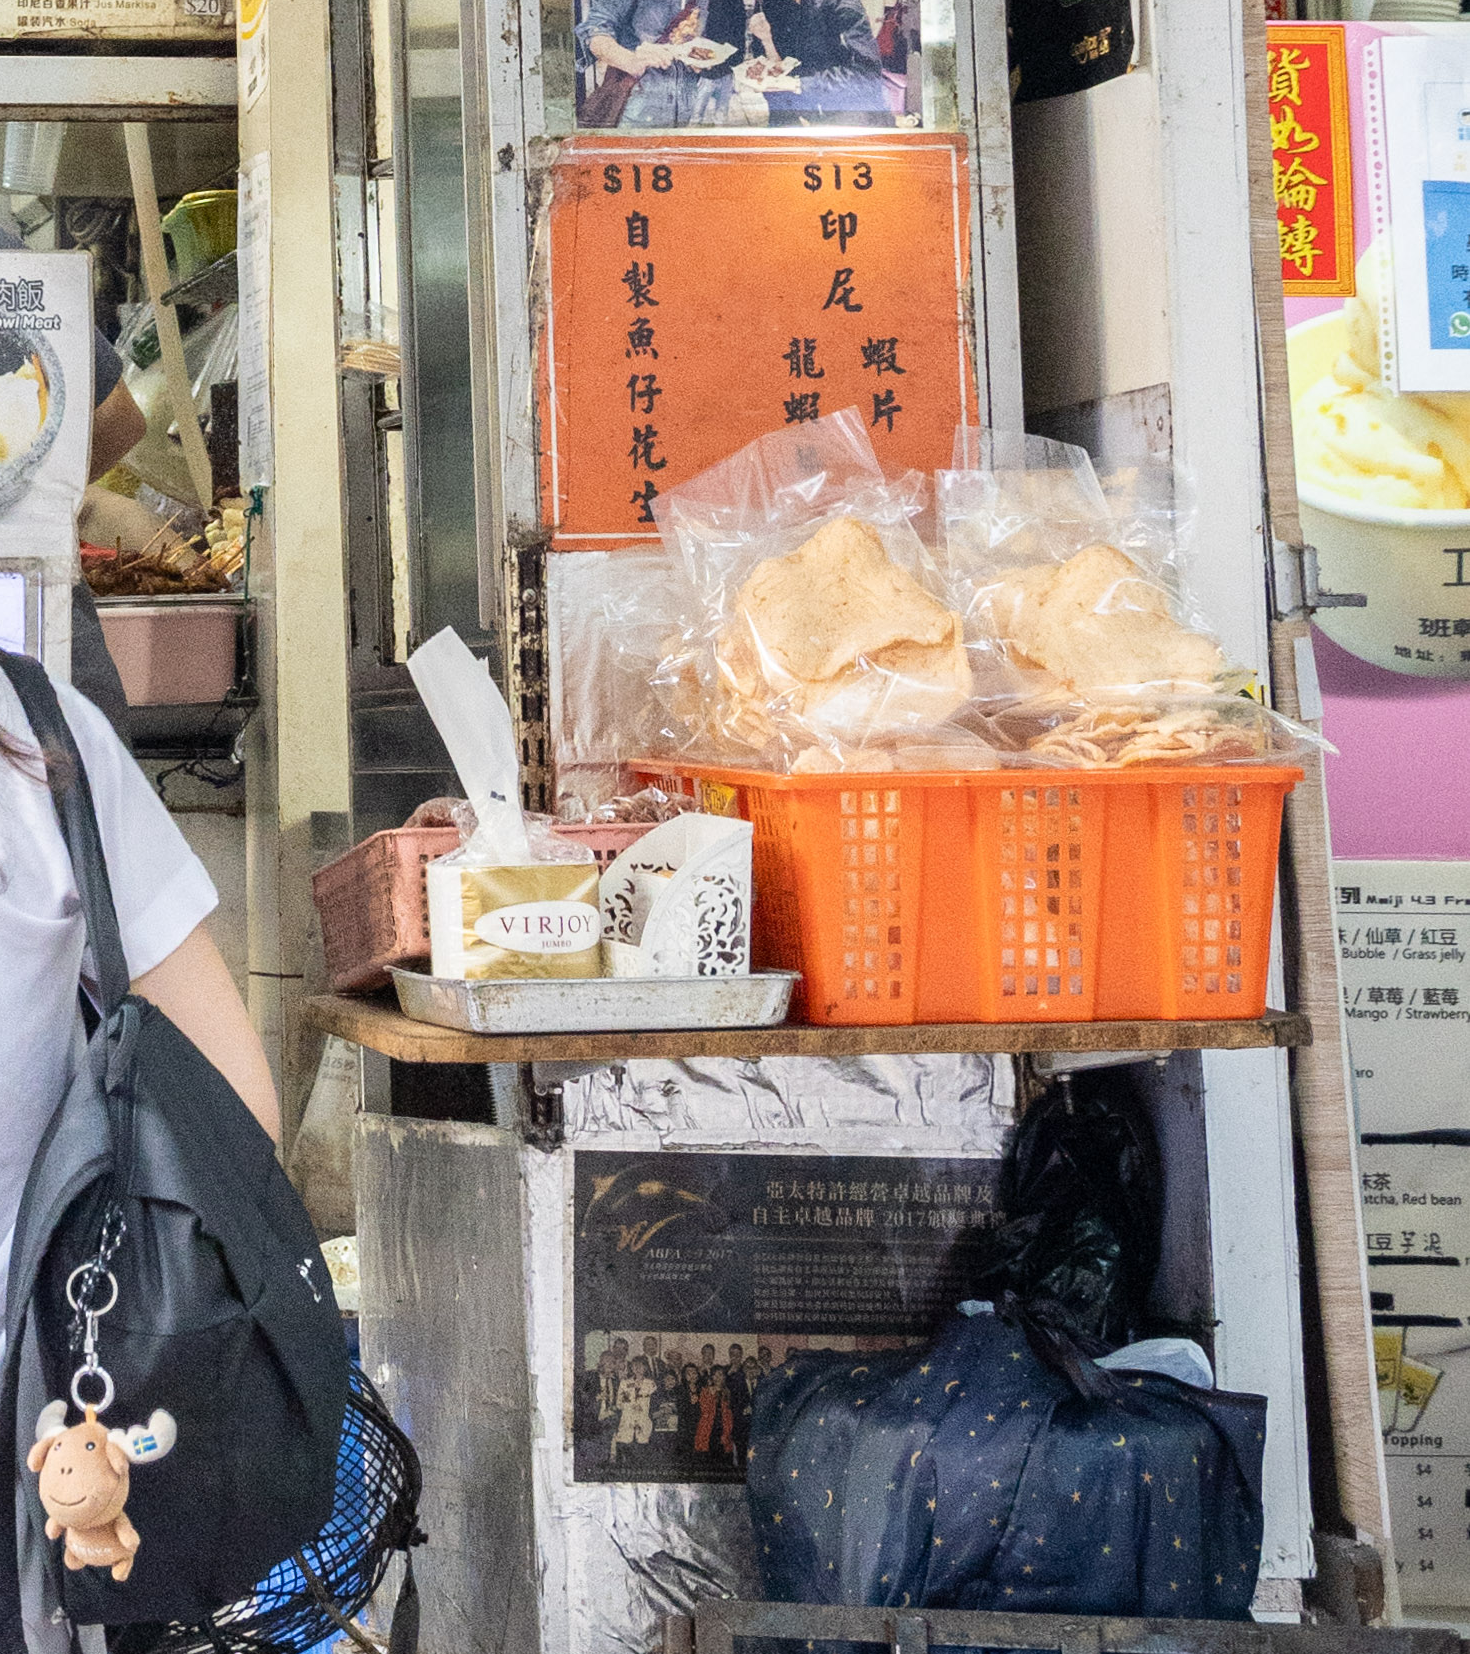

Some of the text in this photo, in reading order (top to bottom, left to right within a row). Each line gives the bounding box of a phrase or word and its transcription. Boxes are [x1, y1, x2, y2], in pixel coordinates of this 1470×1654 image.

[602, 164, 675, 194] $18
[803, 162, 874, 191] $13
[22, 316, 61, 330] Meat
[861, 337, 907, 433] 蝦片
[500, 915, 593, 937] VIRJOY
[542, 940, 571, 948] JUMBO
[1342, 948, 1465, 962] Bubble Grass jelly
